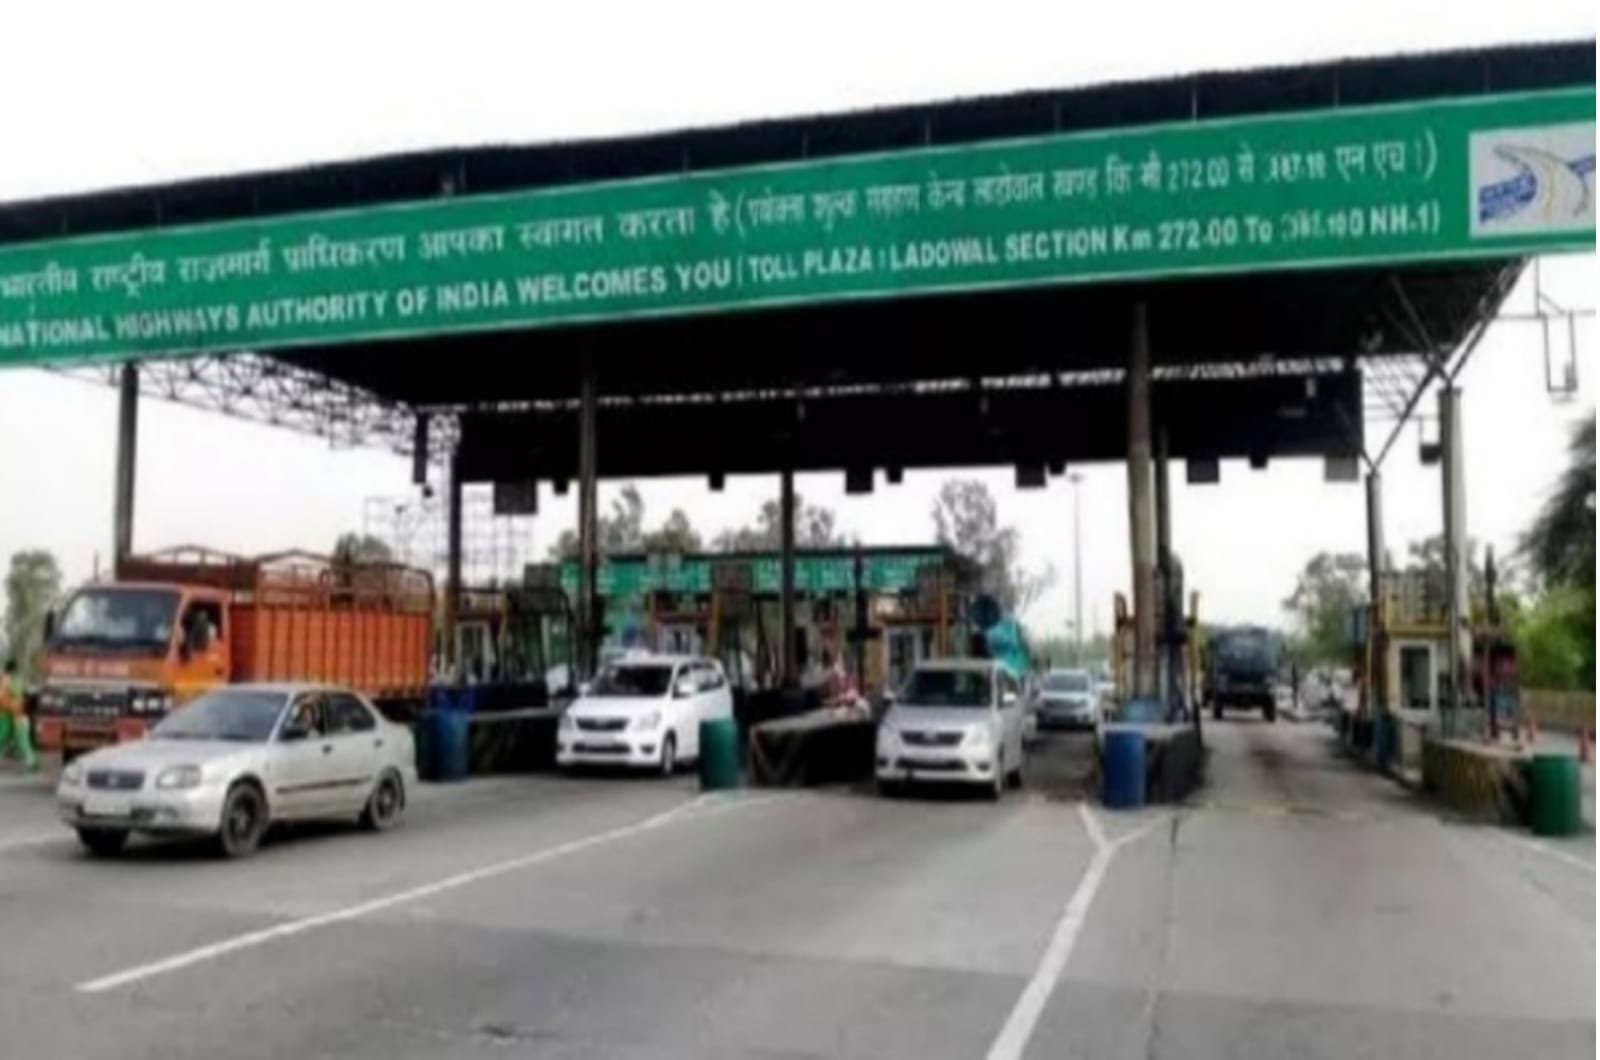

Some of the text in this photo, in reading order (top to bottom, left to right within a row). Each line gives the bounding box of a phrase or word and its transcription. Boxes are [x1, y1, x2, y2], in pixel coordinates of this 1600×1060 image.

[0, 313, 111, 350] NATIONAL
[114, 301, 241, 339] HIGHWAYS
[248, 288, 387, 328] AUTHORITY
[396, 286, 429, 316] OF
[436, 278, 509, 315] INDIA
[516, 264, 668, 305] WELCOMES
[674, 257, 732, 292] YOU
[1005, 225, 1107, 263] SECTION
[1112, 221, 1152, 253] Km
[1244, 213, 1273, 245] To
[419, 222, 506, 262] आपका
[617, 205, 696, 240] करता
